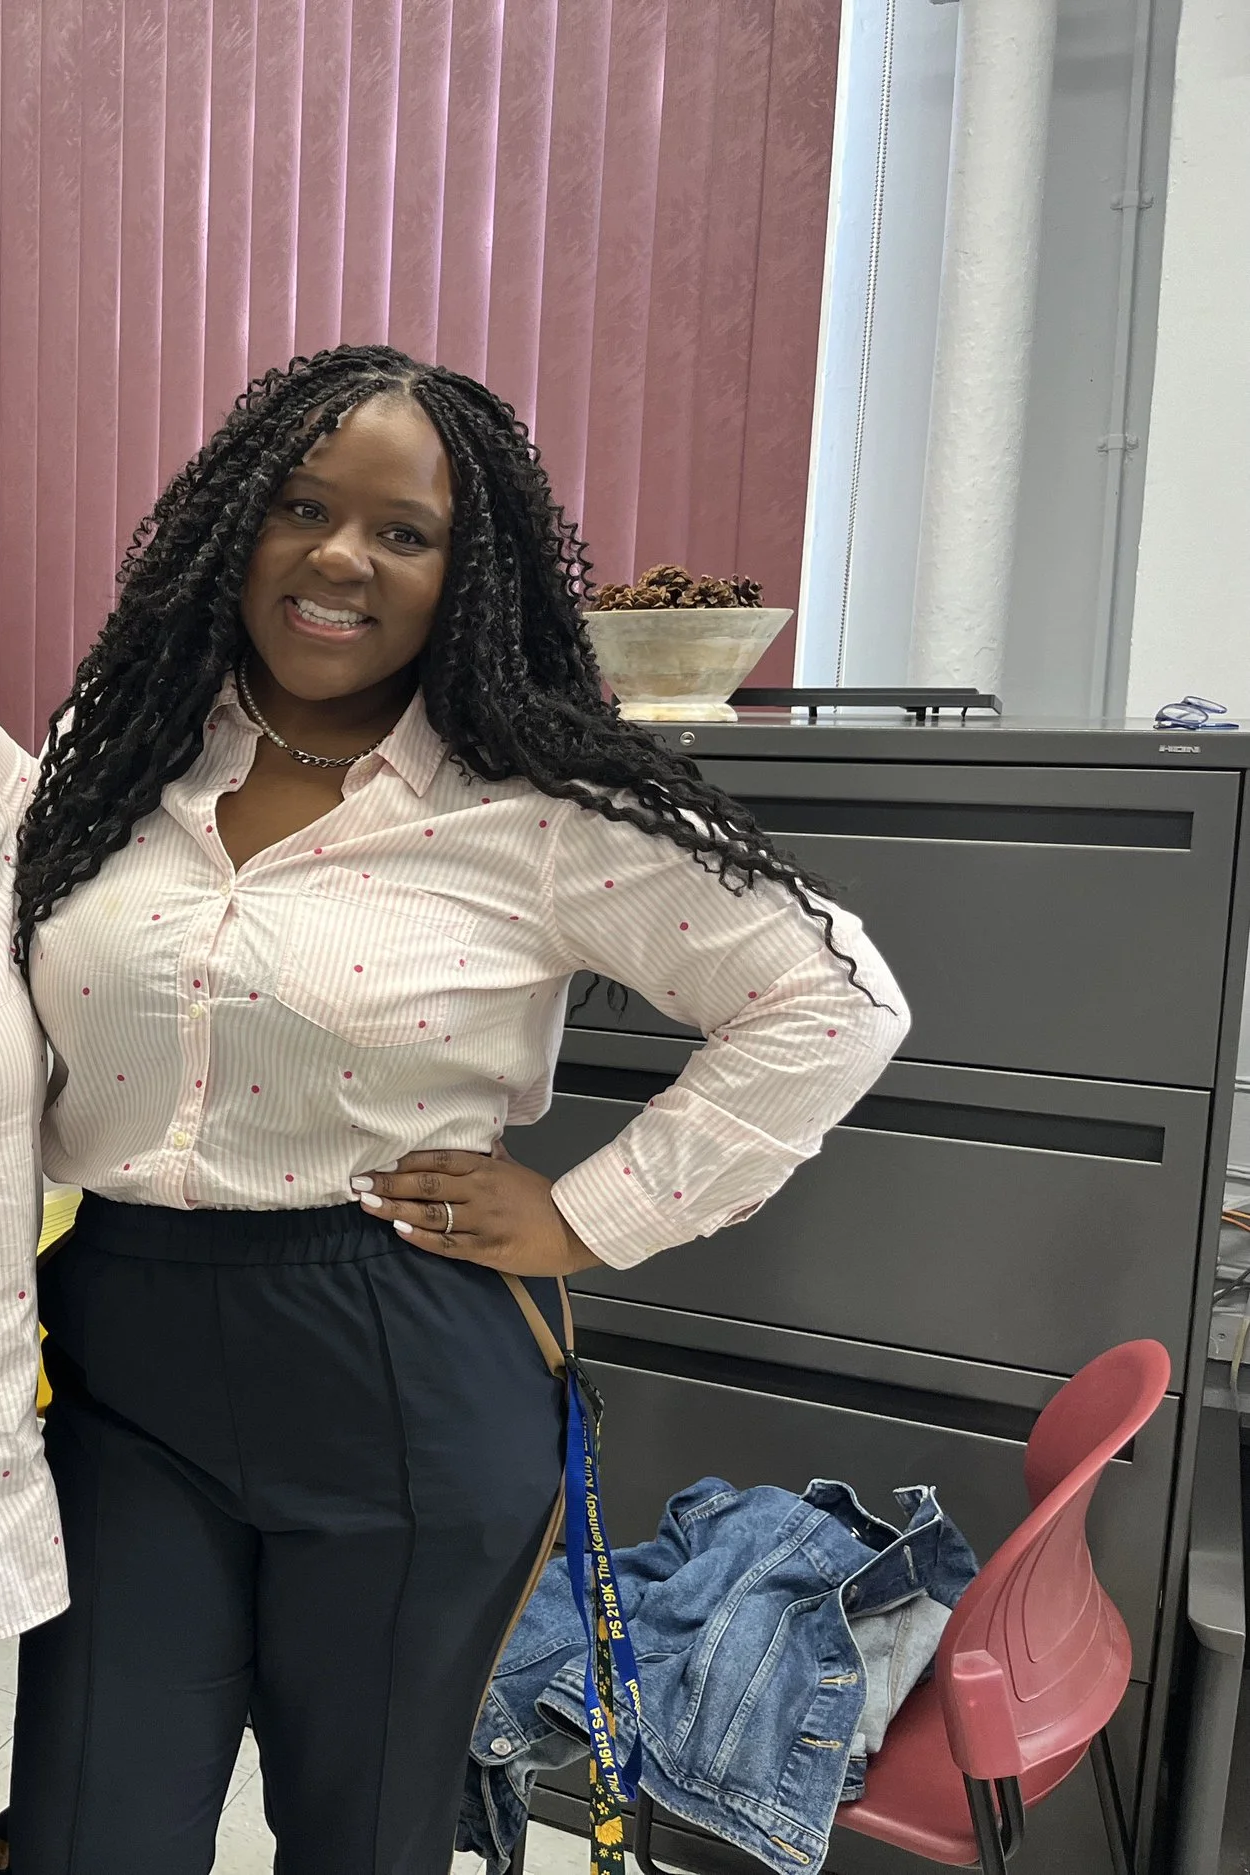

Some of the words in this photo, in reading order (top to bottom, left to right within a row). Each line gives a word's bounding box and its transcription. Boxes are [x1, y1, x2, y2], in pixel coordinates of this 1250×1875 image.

[585, 1492, 605, 1552] Kennedy
[598, 1555, 611, 1580] The
[601, 1583, 619, 1618] 219K
[609, 1620, 625, 1640] PS
[590, 1707, 604, 1729] PS
[594, 1731, 616, 1769] 219K
[605, 1771, 621, 1793] The
